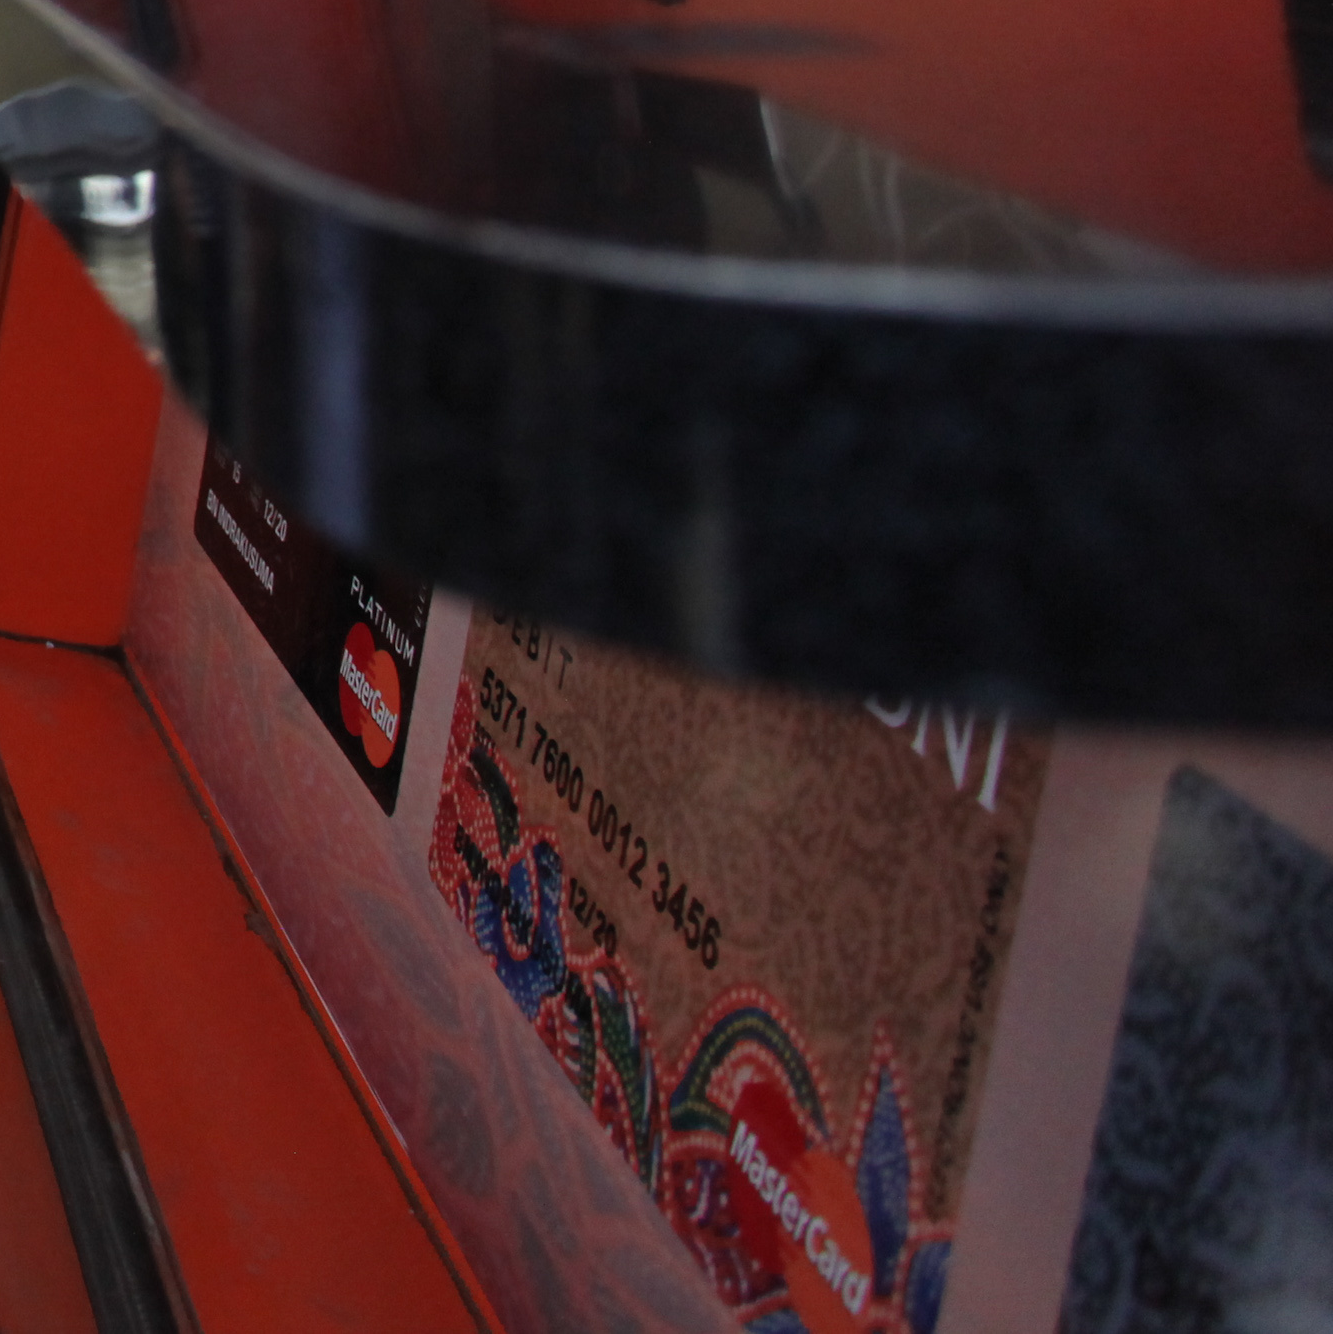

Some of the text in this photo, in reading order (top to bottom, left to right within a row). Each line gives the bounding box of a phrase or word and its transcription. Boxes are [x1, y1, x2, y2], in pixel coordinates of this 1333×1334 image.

[264, 498, 288, 542] 12/20
[350, 575, 415, 667] PLATINUM
[493, 614, 573, 690] EBIT
[339, 648, 398, 743] MasterCard
[480, 667, 527, 748] 5371
[531, 722, 584, 813] 7600
[588, 788, 648, 890] 0012
[652, 861, 721, 970] 3456
[569, 877, 617, 959] 12/20
[729, 1120, 871, 1315] MasterCard
